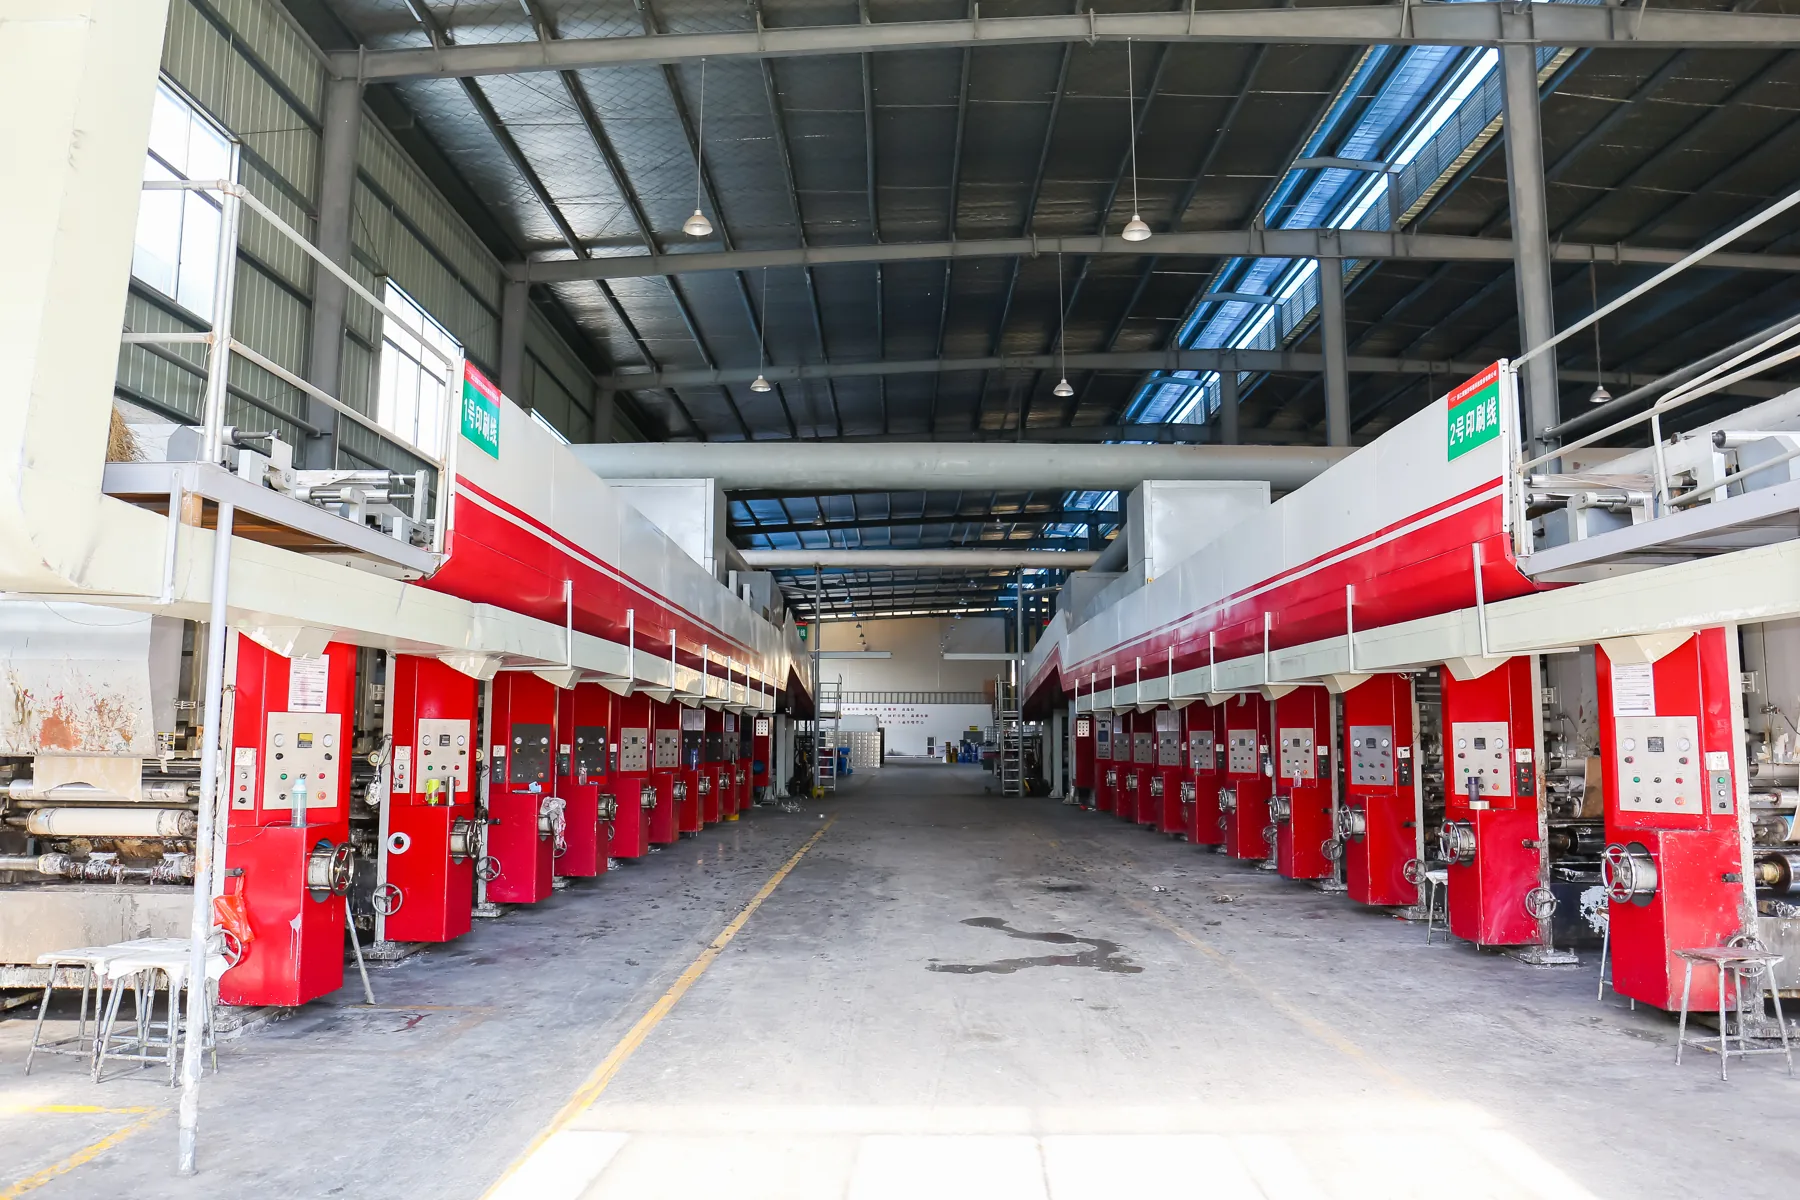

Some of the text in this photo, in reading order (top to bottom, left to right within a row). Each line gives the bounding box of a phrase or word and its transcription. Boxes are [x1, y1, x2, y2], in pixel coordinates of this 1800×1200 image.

[464, 398, 497, 447] 1号印刷线
[1450, 396, 1497, 446] 2号印刷线
